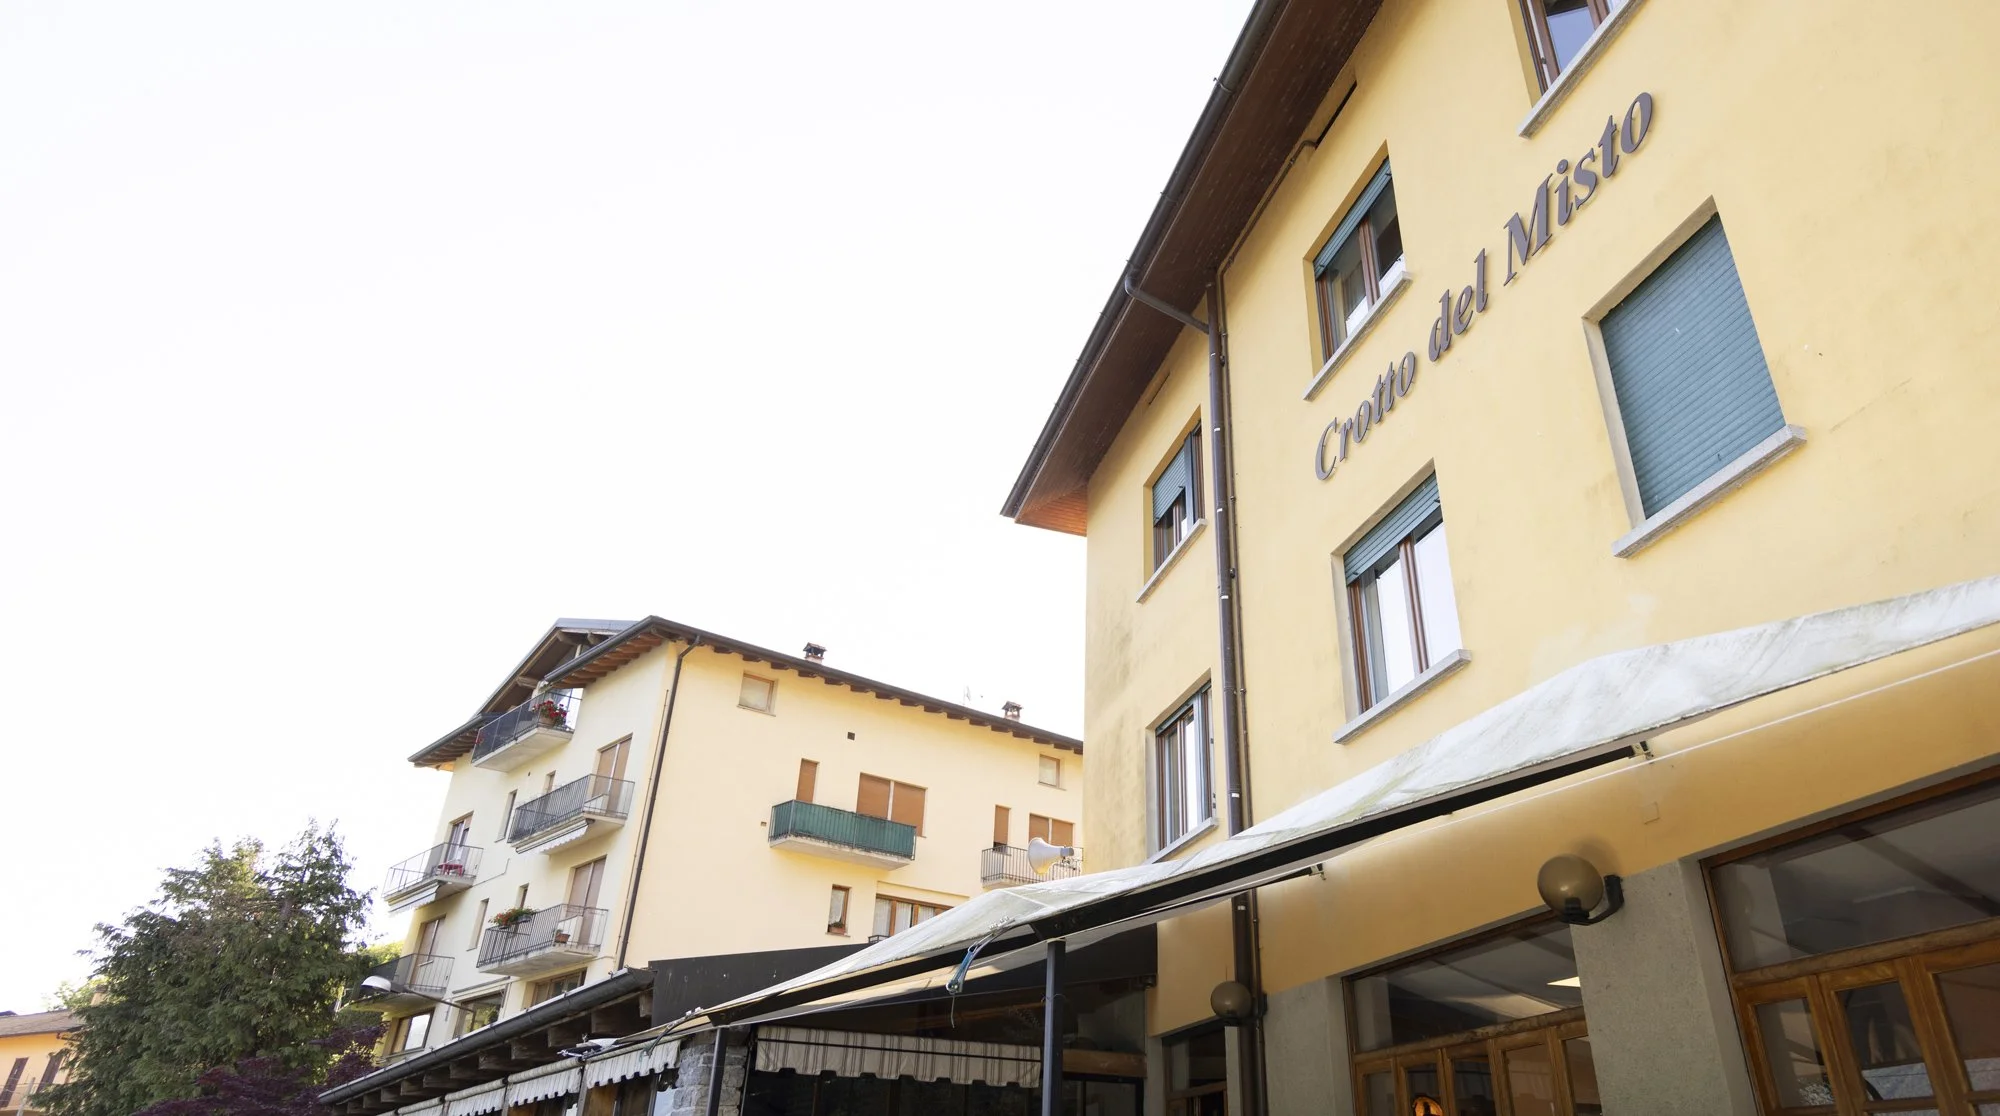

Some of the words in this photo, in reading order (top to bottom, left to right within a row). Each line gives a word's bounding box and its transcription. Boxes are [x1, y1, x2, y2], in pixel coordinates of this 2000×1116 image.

[1315, 351, 1417, 480] Crotto
[1428, 247, 1489, 362] del
[1503, 92, 1654, 286] Misto
